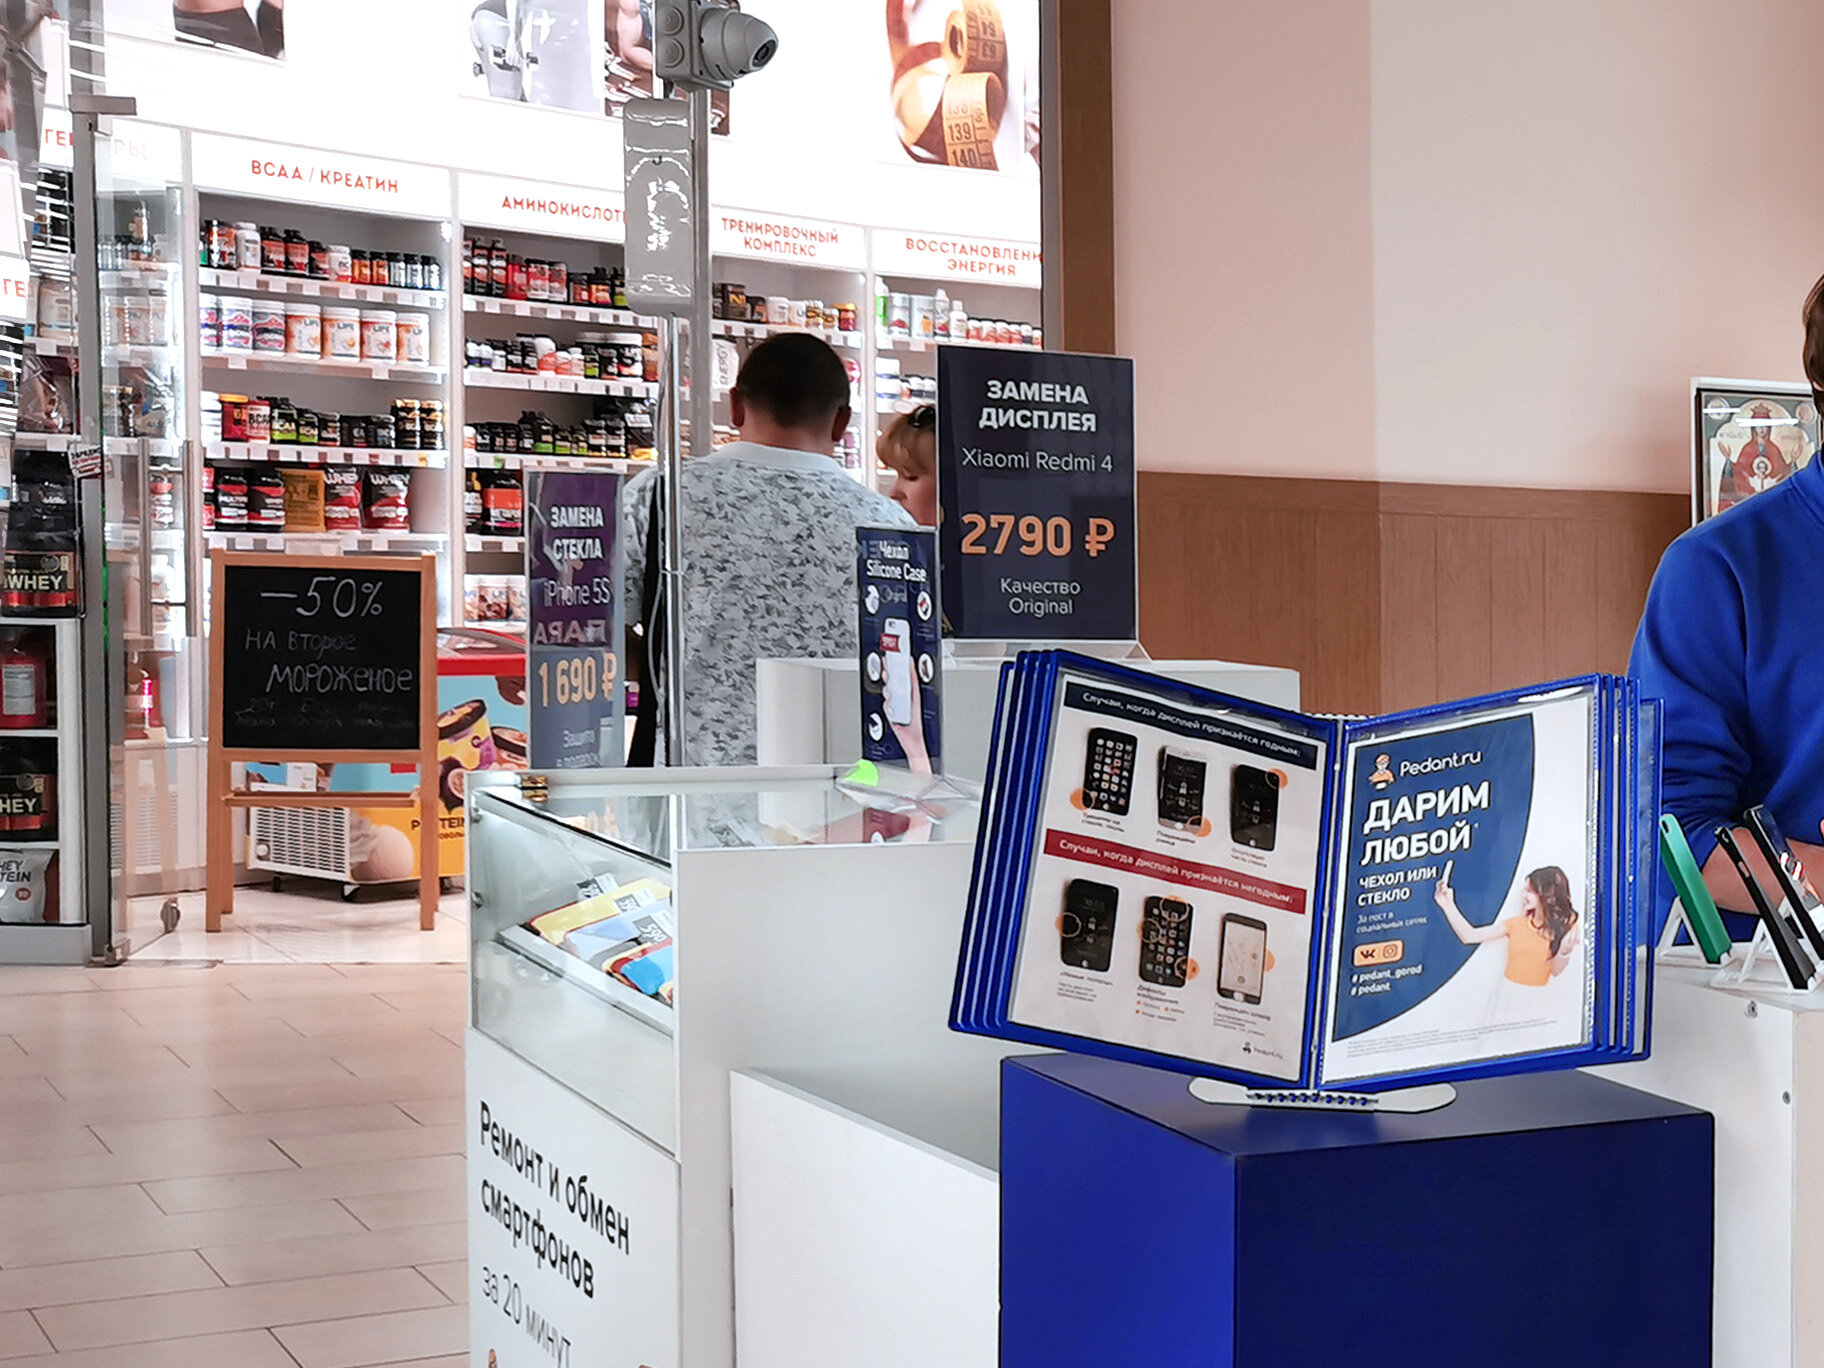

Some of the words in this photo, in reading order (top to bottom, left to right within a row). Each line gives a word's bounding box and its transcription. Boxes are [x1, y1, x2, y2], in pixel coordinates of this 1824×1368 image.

[948, 122, 972, 142] 139
[951, 148, 977, 167] 140
[320, 169, 399, 194] КРЕАТИН
[502, 195, 626, 223] АМИНОКИСЛОТ
[721, 217, 839, 244] ТРЕНИРОВОЧНЫЙ
[744, 236, 817, 257] КОМПЛЕКС
[906, 237, 1042, 262] ВОССТАНОВЛЕНИ
[947, 259, 1016, 276] ЭНЕРГИЯ
[986, 380, 1089, 406] ЗАМЕНА
[978, 405, 1097, 434] ДИСПЛЕЯ
[962, 448, 1031, 472] Xiaomi
[1036, 450, 1096, 473] Redmi
[1101, 454, 1114, 474] 4
[550, 505, 604, 529] ЗАМЕНА
[961, 511, 1073, 558] 2790
[553, 538, 603, 561] СТЕКЛА
[880, 541, 910, 560] Чехол
[7, 574, 63, 590] WHEY
[866, 560, 903, 578] Silicone
[904, 564, 928, 583] Case
[544, 580, 590, 607] iPhone
[592, 577, 611, 605] 5S
[1000, 578, 1081, 597] Качество
[1008, 596, 1073, 617] Original
[245, 629, 277, 651] НА
[539, 661, 549, 707] 1
[556, 656, 597, 705] 690
[1082, 692, 1124, 709] Случаи,
[1126, 703, 1157, 718] когда
[1158, 709, 1200, 730] дисплей
[1399, 750, 1483, 778] Pedant.ru
[0, 798, 37, 813] HEY
[1362, 781, 1490, 836] ДАРИМ
[1360, 820, 1473, 867] ЛЮБОЙ
[0, 860, 24, 871] HEY
[1059, 838, 1101, 857] Случаи,
[1103, 849, 1134, 865] когда
[1135, 857, 1179, 875] дисплей
[0, 871, 32, 883] TEIN
[1358, 870, 1405, 891] ЧЕХОЛ
[1407, 865, 1437, 882] ИЛИ
[1357, 886, 1411, 908] СТЕКЛО
[480, 1100, 543, 1189] Ремонт
[549, 1162, 559, 1203] и
[566, 1175, 629, 1255] обмен
[482, 1179, 594, 1299] смартфонов
[483, 1266, 499, 1305] за
[503, 1274, 522, 1325] 20
